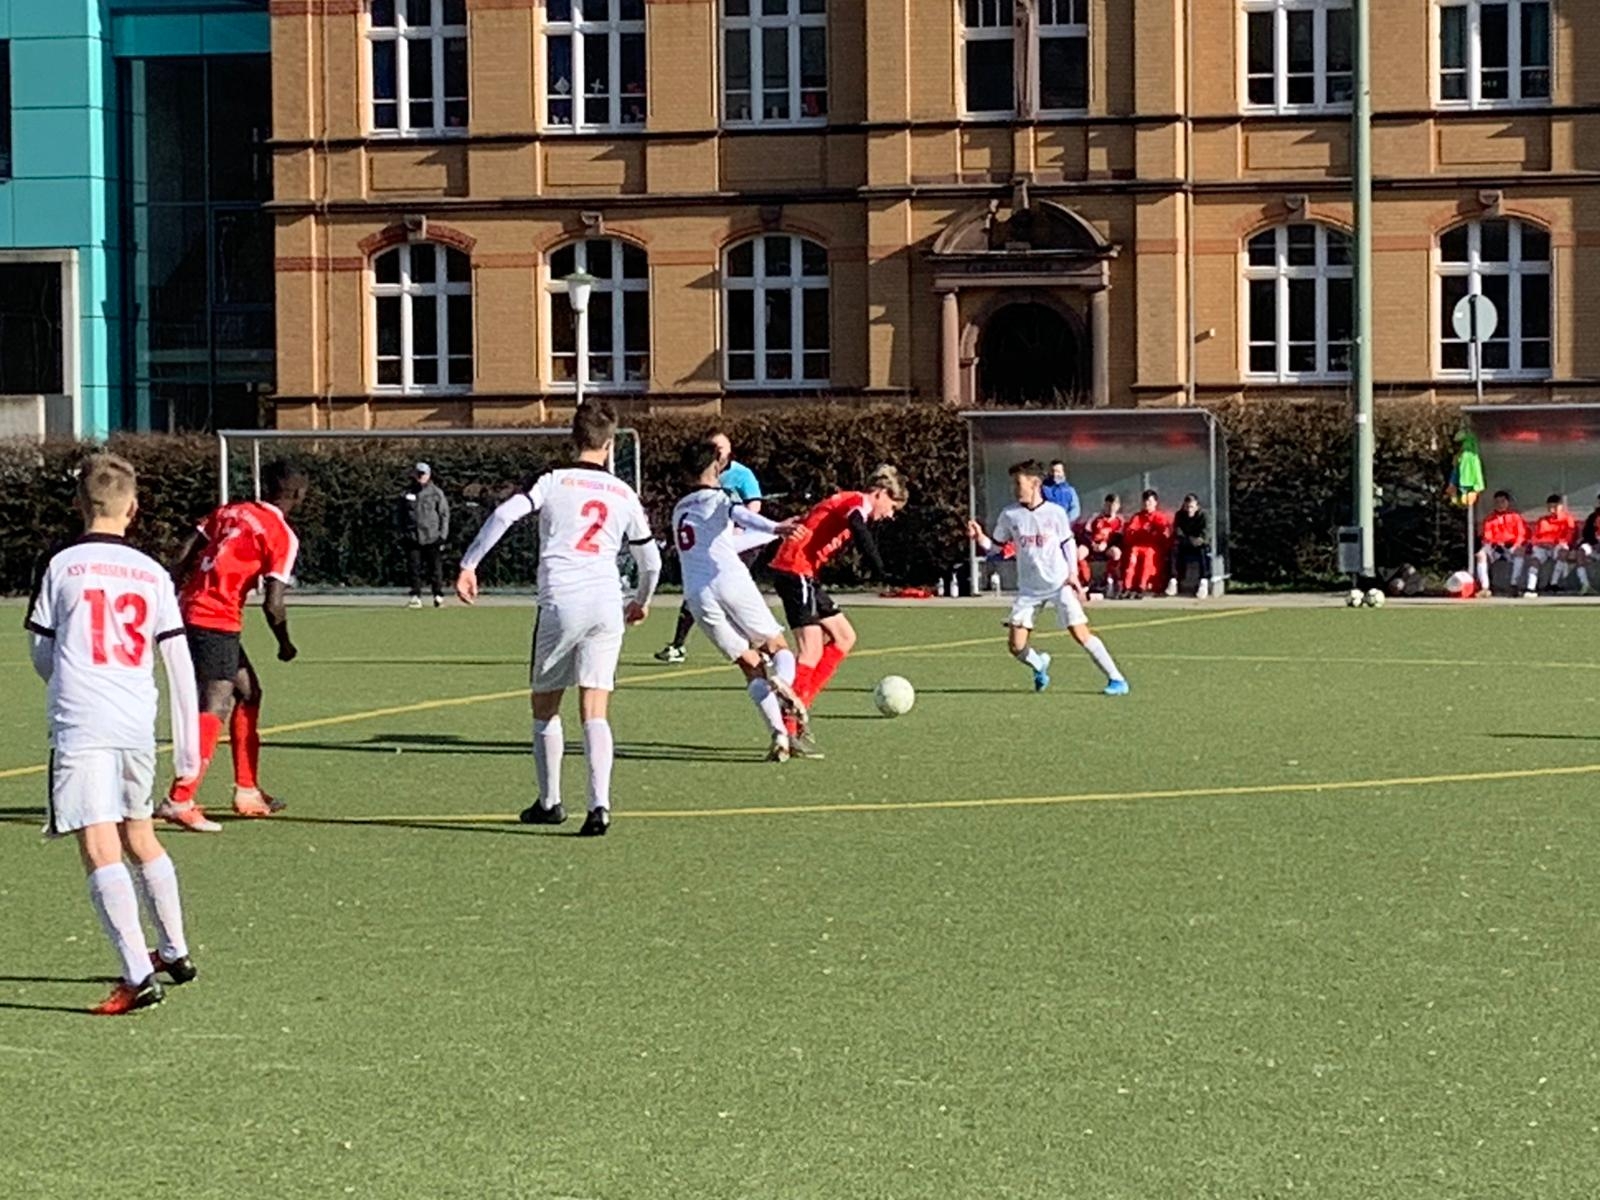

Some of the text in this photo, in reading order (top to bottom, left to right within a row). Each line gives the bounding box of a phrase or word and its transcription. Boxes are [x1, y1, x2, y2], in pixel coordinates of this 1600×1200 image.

[575, 499, 608, 554] 2
[678, 512, 695, 551] 6
[90, 562, 128, 578] SSEN
[83, 589, 147, 667] 13
